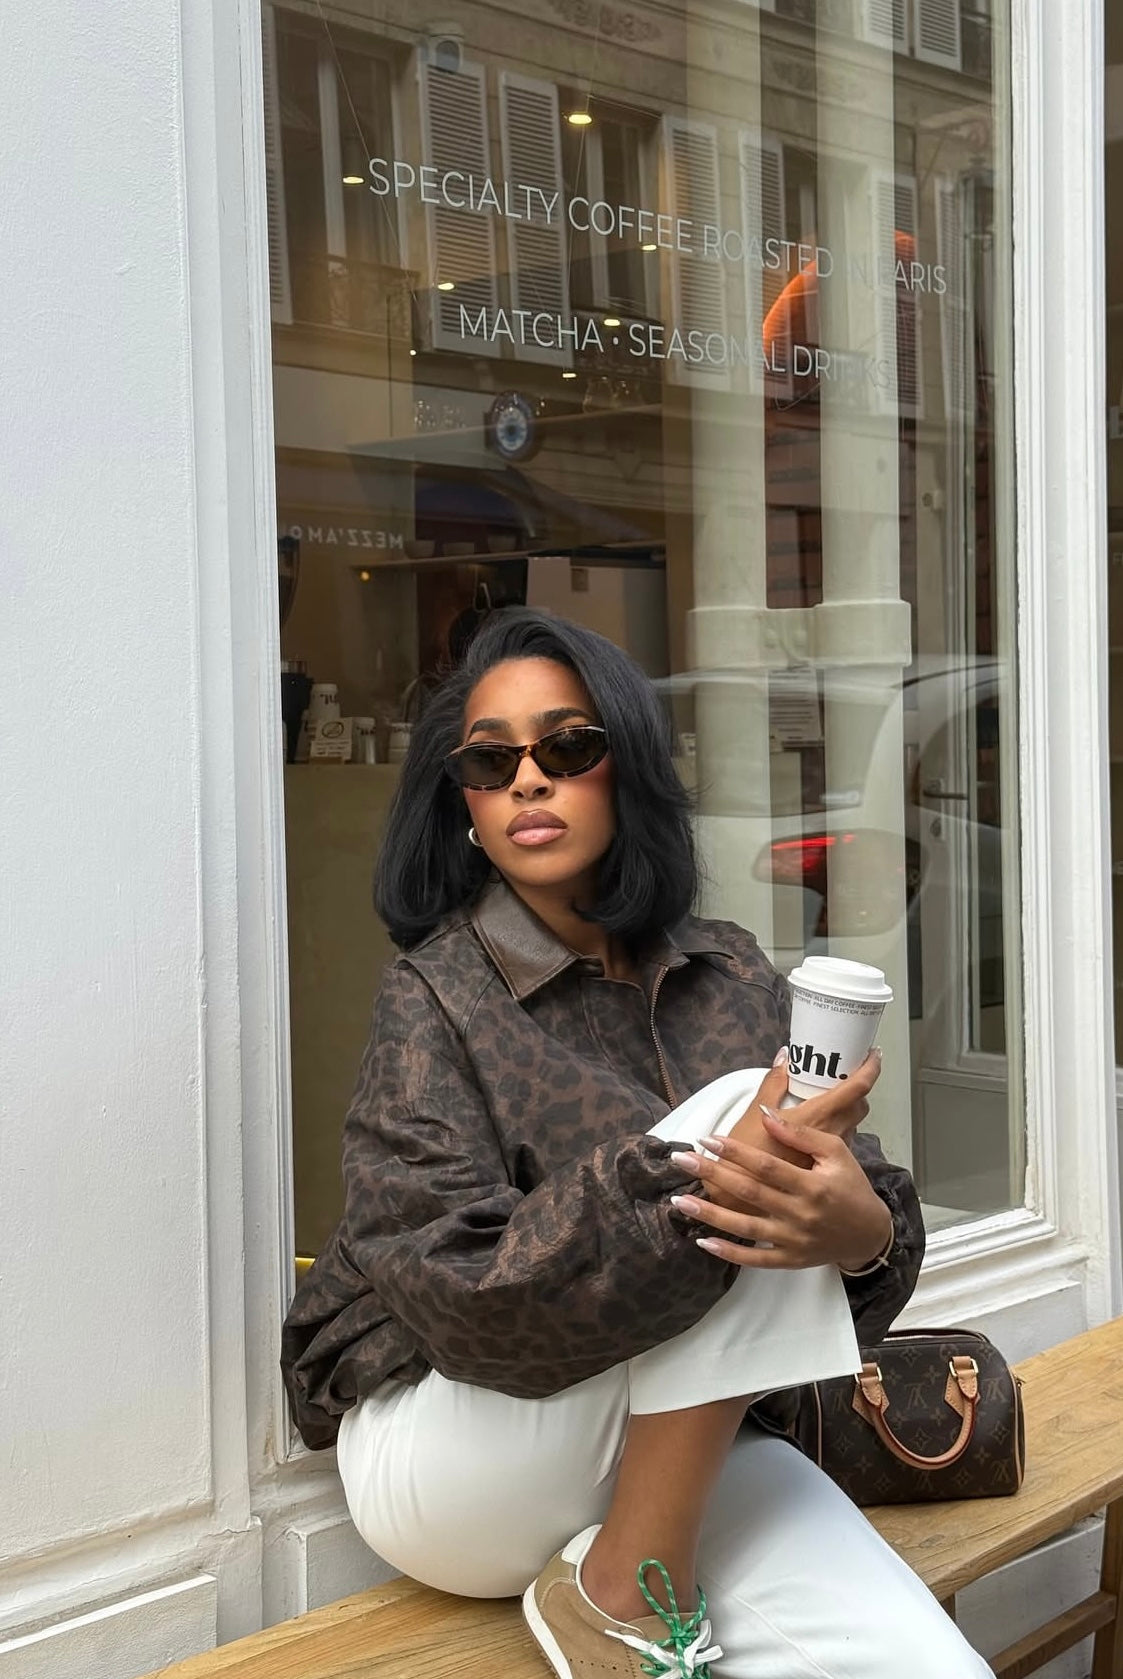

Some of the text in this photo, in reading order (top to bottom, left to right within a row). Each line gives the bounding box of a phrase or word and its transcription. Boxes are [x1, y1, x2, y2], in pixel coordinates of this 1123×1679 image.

[368, 157, 559, 224] SPECIALTY
[568, 196, 693, 253] COFFEE
[702, 223, 834, 278] ROASTED
[459, 303, 890, 388] MATCHA SEASONAL DRIKS
